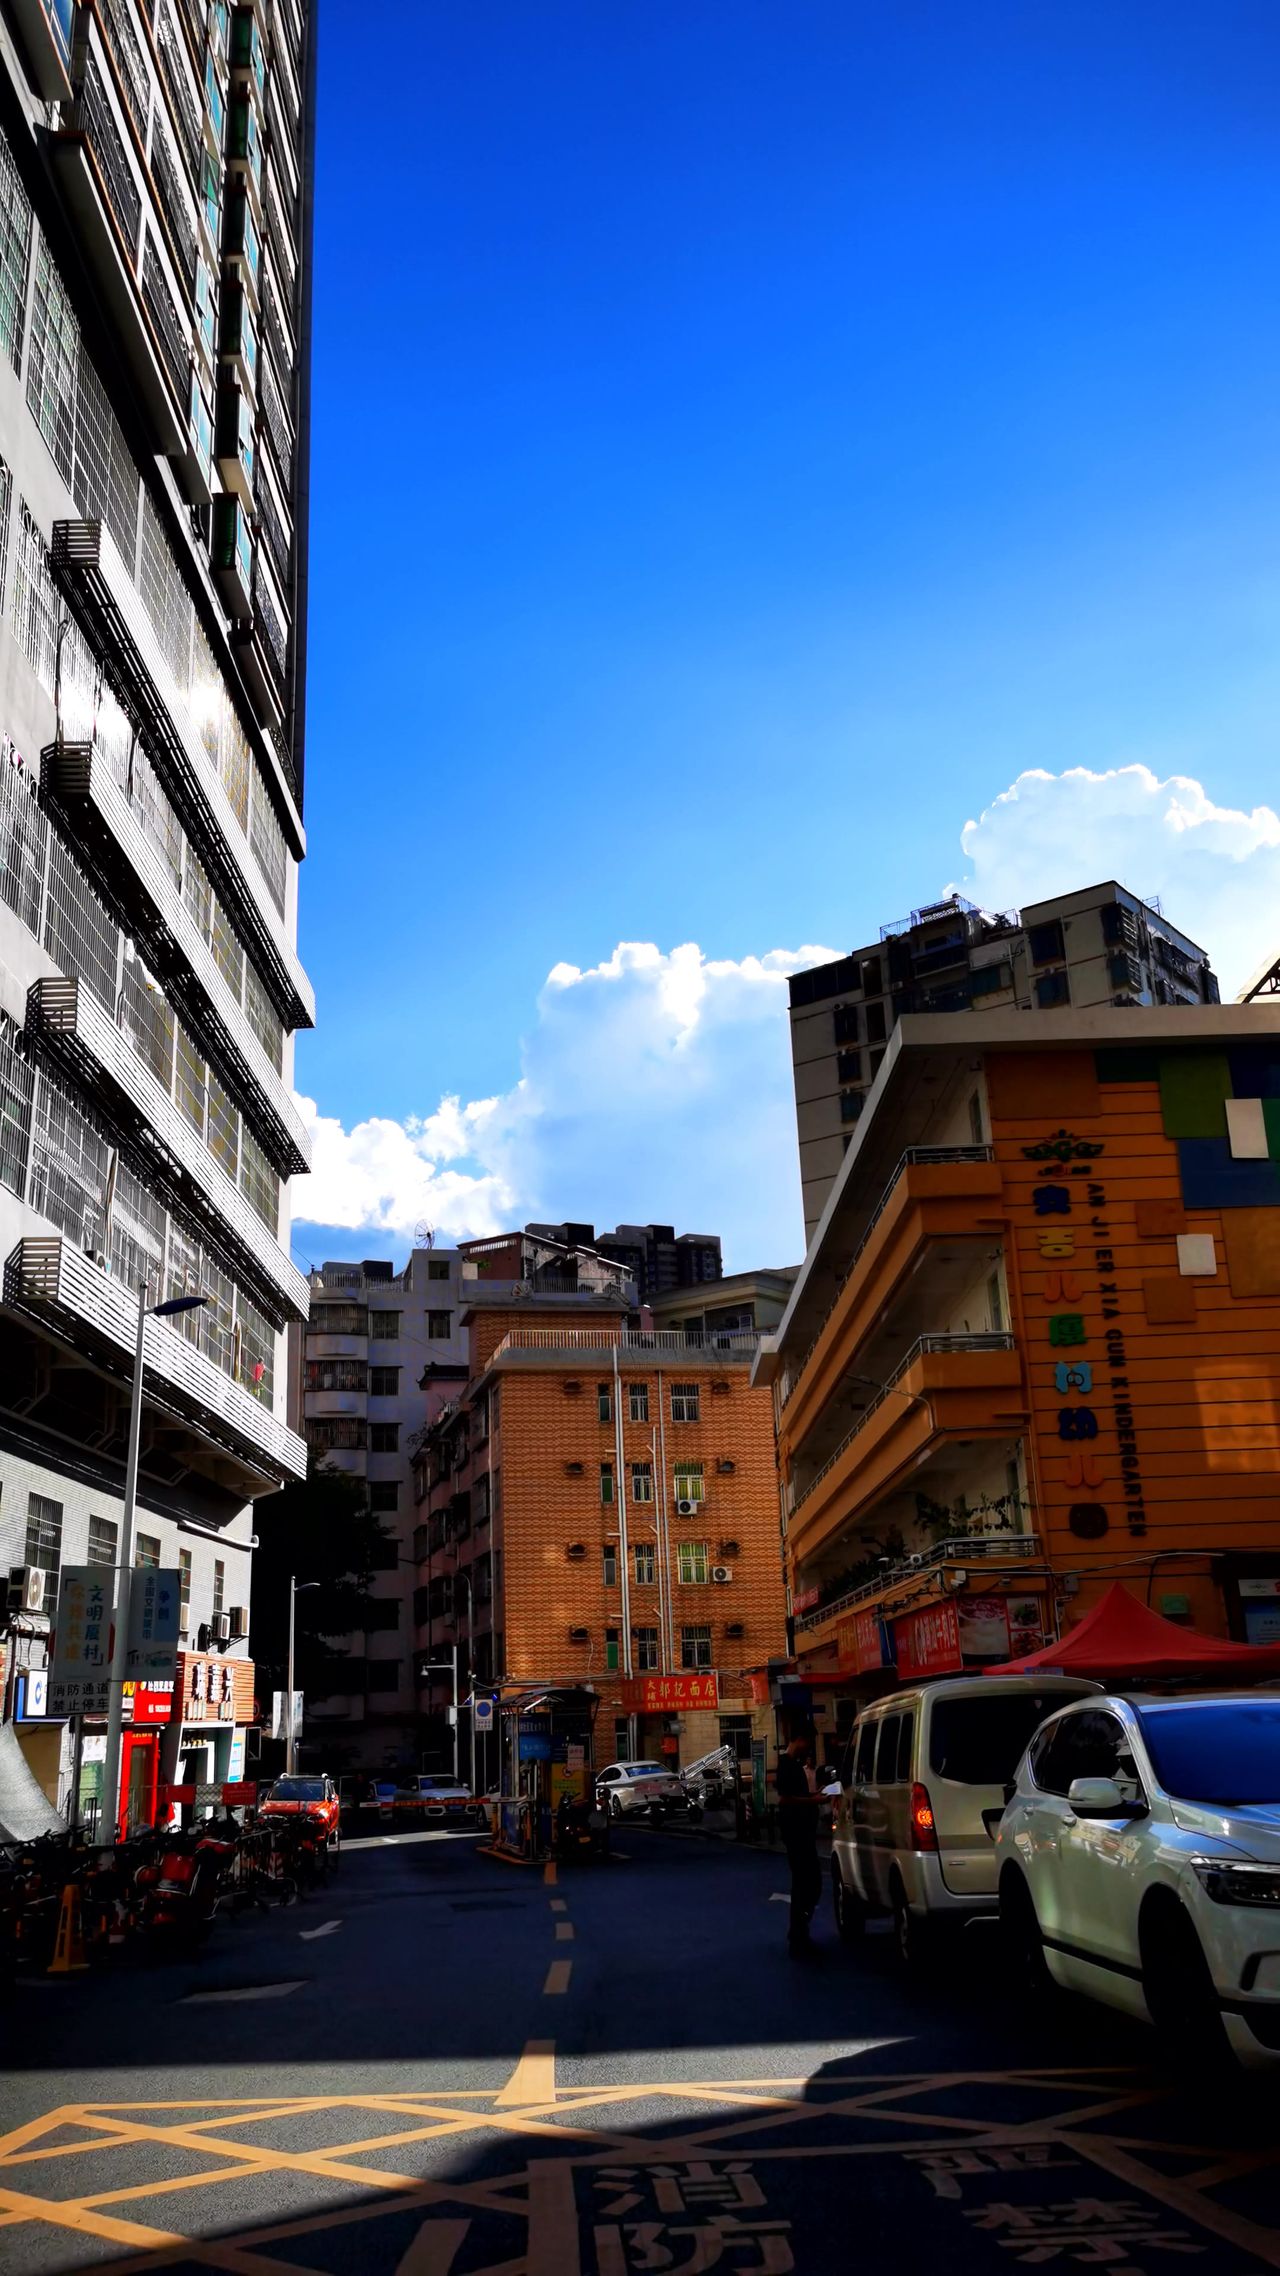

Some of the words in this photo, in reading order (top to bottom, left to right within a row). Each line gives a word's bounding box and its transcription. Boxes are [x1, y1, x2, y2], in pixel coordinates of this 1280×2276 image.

[1088, 1183, 1106, 1207] AN
[1091, 1216, 1110, 1237] JI
[1096, 1249, 1115, 1273] ER
[1099, 1282, 1121, 1320] XIA
[1112, 1377, 1148, 1537] KINDERGARTEN
[53, 1682, 109, 1696] 消防通道
[53, 1698, 109, 1712] 禁止停车
